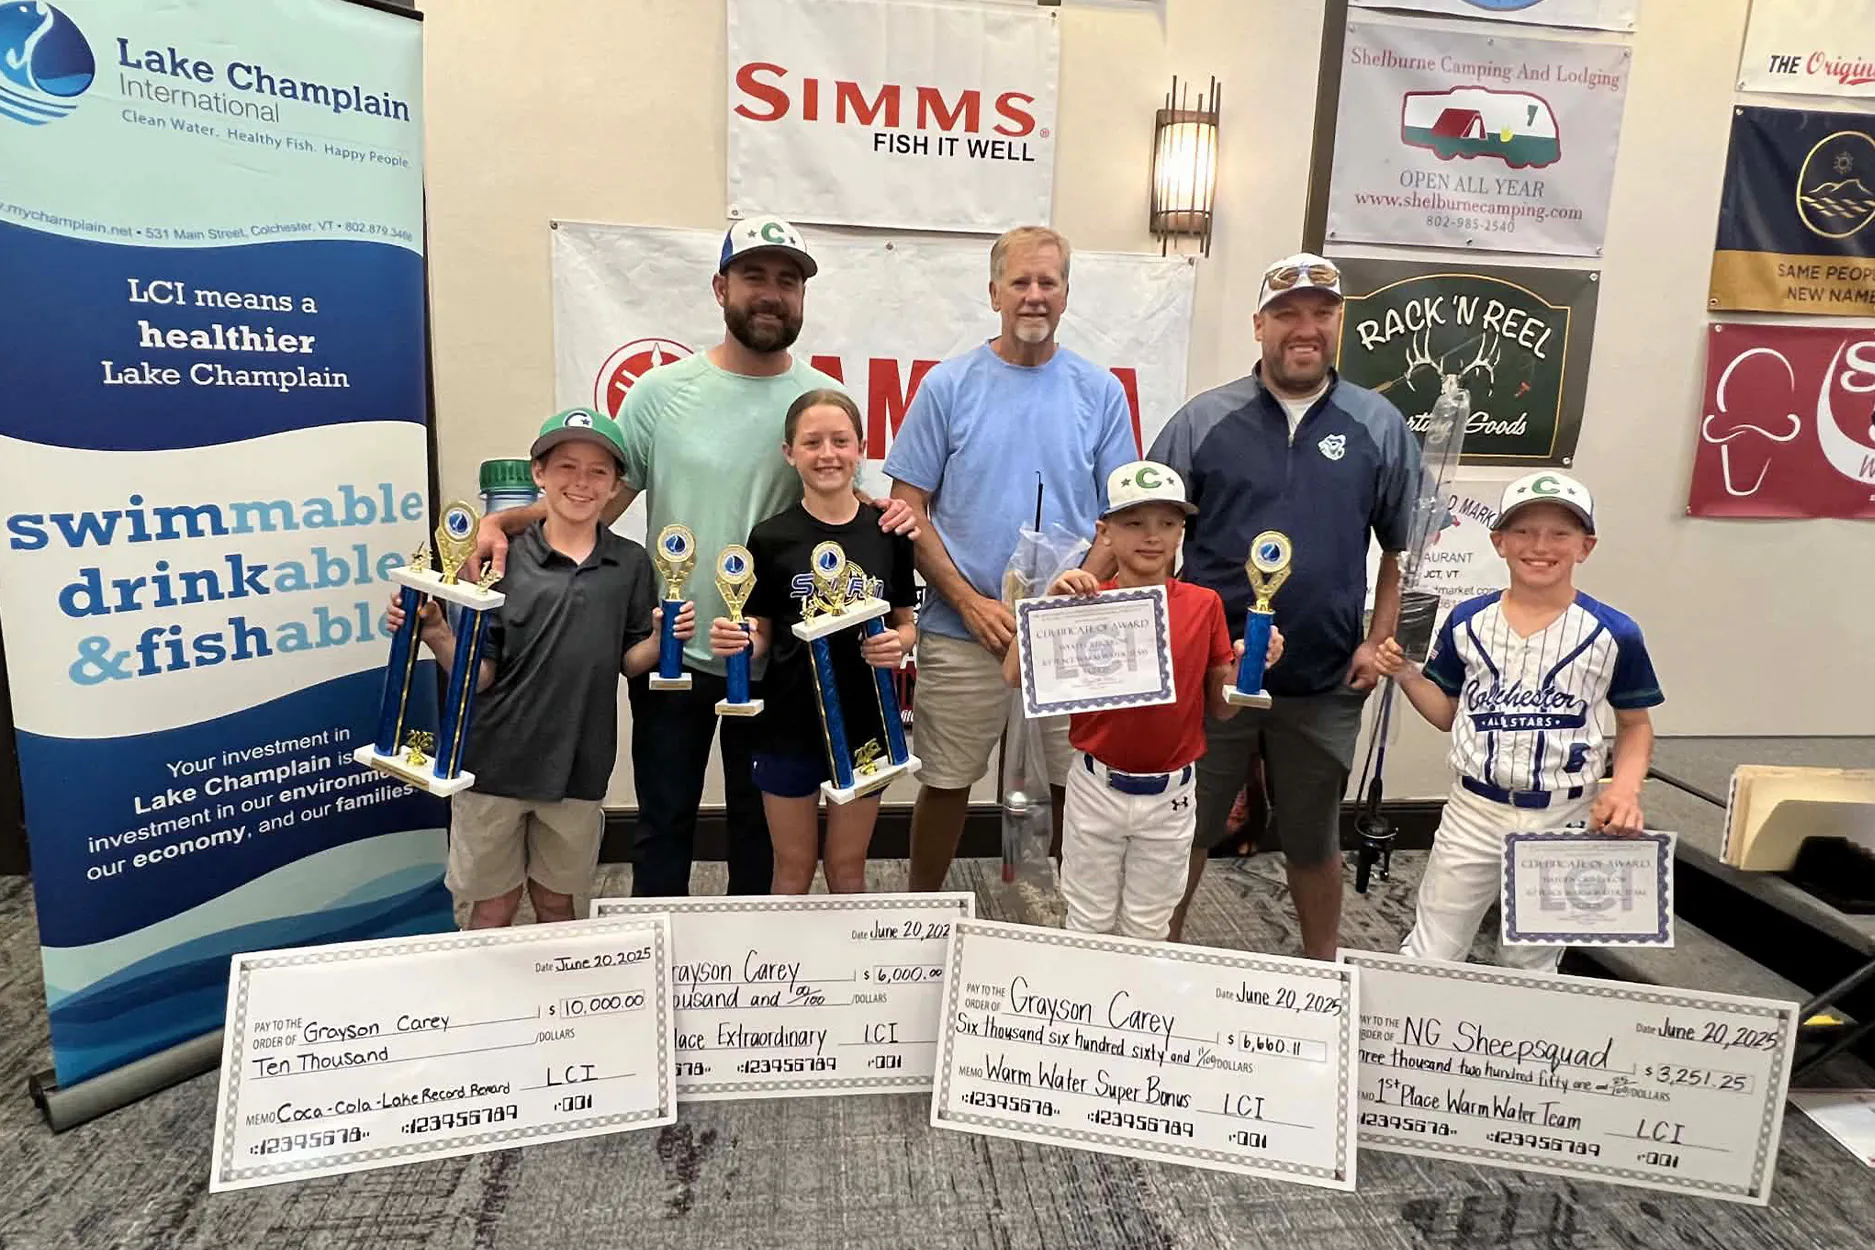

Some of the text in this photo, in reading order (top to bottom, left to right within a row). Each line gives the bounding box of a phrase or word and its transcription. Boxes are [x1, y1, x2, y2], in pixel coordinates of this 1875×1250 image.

[116, 37, 410, 122] Lake Champlain
[1351, 48, 1620, 90] Shelburne Camping And Lodging
[1768, 55, 1802, 74] THE
[120, 73, 280, 123] International
[734, 62, 1036, 137] SIMMS
[122, 109, 166, 129] Clean
[171, 118, 220, 138] Water.
[228, 128, 282, 148] Healthy
[287, 137, 316, 153] Fish.
[324, 143, 365, 162] Happy
[874, 133, 1034, 162] FISH IT WELL
[1400, 170, 1545, 198] OPEN ALL YEAR
[1355, 192, 1582, 222] www.shelburnecamping.com
[146, 227, 170, 241] 531
[174, 228, 206, 241] Main
[318, 220, 334, 232] VT
[1778, 264, 1820, 280] SAME
[127, 278, 318, 315] LCI means a
[1788, 287, 1824, 302] NEW
[138, 320, 316, 354] healthier
[1357, 296, 1552, 359] RACK 'N REEL
[101, 361, 350, 392] Lake Champlain
[1463, 412, 1528, 436] Goods
[1135, 467, 1162, 489] C
[1531, 476, 1561, 494] C
[7, 483, 424, 551] swimmable
[1424, 553, 1473, 563] AURANT
[58, 544, 405, 619] drinkable
[1447, 570, 1459, 578] VT
[1468, 680, 1578, 711] Colchester
[1511, 717, 1552, 727] STARS
[167, 727, 351, 779] Your investment in
[134, 751, 352, 815] Lake Champlain is
[88, 811, 211, 853] investment
[217, 803, 234, 820] in
[242, 796, 273, 813] our
[86, 859, 126, 881] our
[132, 824, 252, 868] economy,
[259, 813, 294, 833] and
[301, 804, 331, 822] our
[870, 920, 898, 939] June
[535, 962, 554, 974] Date
[554, 956, 591, 972] June
[672, 951, 801, 993] rayson Carey
[750, 991, 781, 1007] and
[965, 1000, 990, 1010] ORDER
[967, 983, 1005, 997] PAY TO THE
[1215, 987, 1234, 1000] Date
[1236, 982, 1270, 1006] June
[1304, 995, 1343, 1016] 2025
[254, 1018, 302, 1032] PAY TO THE
[304, 1014, 450, 1043] Grayson Carey
[1011, 976, 1175, 1051] Grayson Carey
[1374, 1017, 1399, 1028] TO THE
[1658, 1017, 1695, 1040] June
[253, 1035, 296, 1049] ORDER OF
[674, 1028, 705, 1049] lace
[718, 1022, 827, 1055] Extraordinary
[955, 1012, 978, 1034] Six
[1049, 1029, 1070, 1046] six
[1075, 1029, 1125, 1056] hundred
[1132, 1045, 1164, 1067] sixty
[1170, 1049, 1190, 1064] and
[1216, 1060, 1253, 1074] DOLLARS
[1384, 1032, 1394, 1040] OF
[1404, 1015, 1613, 1071] NG Sheepsquad
[252, 1028, 575, 1077] Ten Thousand DOLLARS
[1392, 1047, 1452, 1072] thousand
[1459, 1058, 1481, 1076] two
[1485, 1060, 1533, 1082] hundred
[246, 1112, 275, 1126] MEMO
[422, 1084, 465, 1102] Record
[546, 1064, 598, 1087] LCI
[959, 1066, 983, 1079] MEMO
[985, 1054, 1032, 1087] Warm
[1038, 1061, 1086, 1094] Water
[1096, 1069, 1140, 1104] Super
[1146, 1077, 1191, 1108] Bonus
[1401, 1084, 1440, 1109] Place
[1448, 1088, 1489, 1118] Warm
[1493, 1095, 1536, 1123] Water
[1538, 1101, 1582, 1130] Team
[1637, 1119, 1686, 1144] LCI
